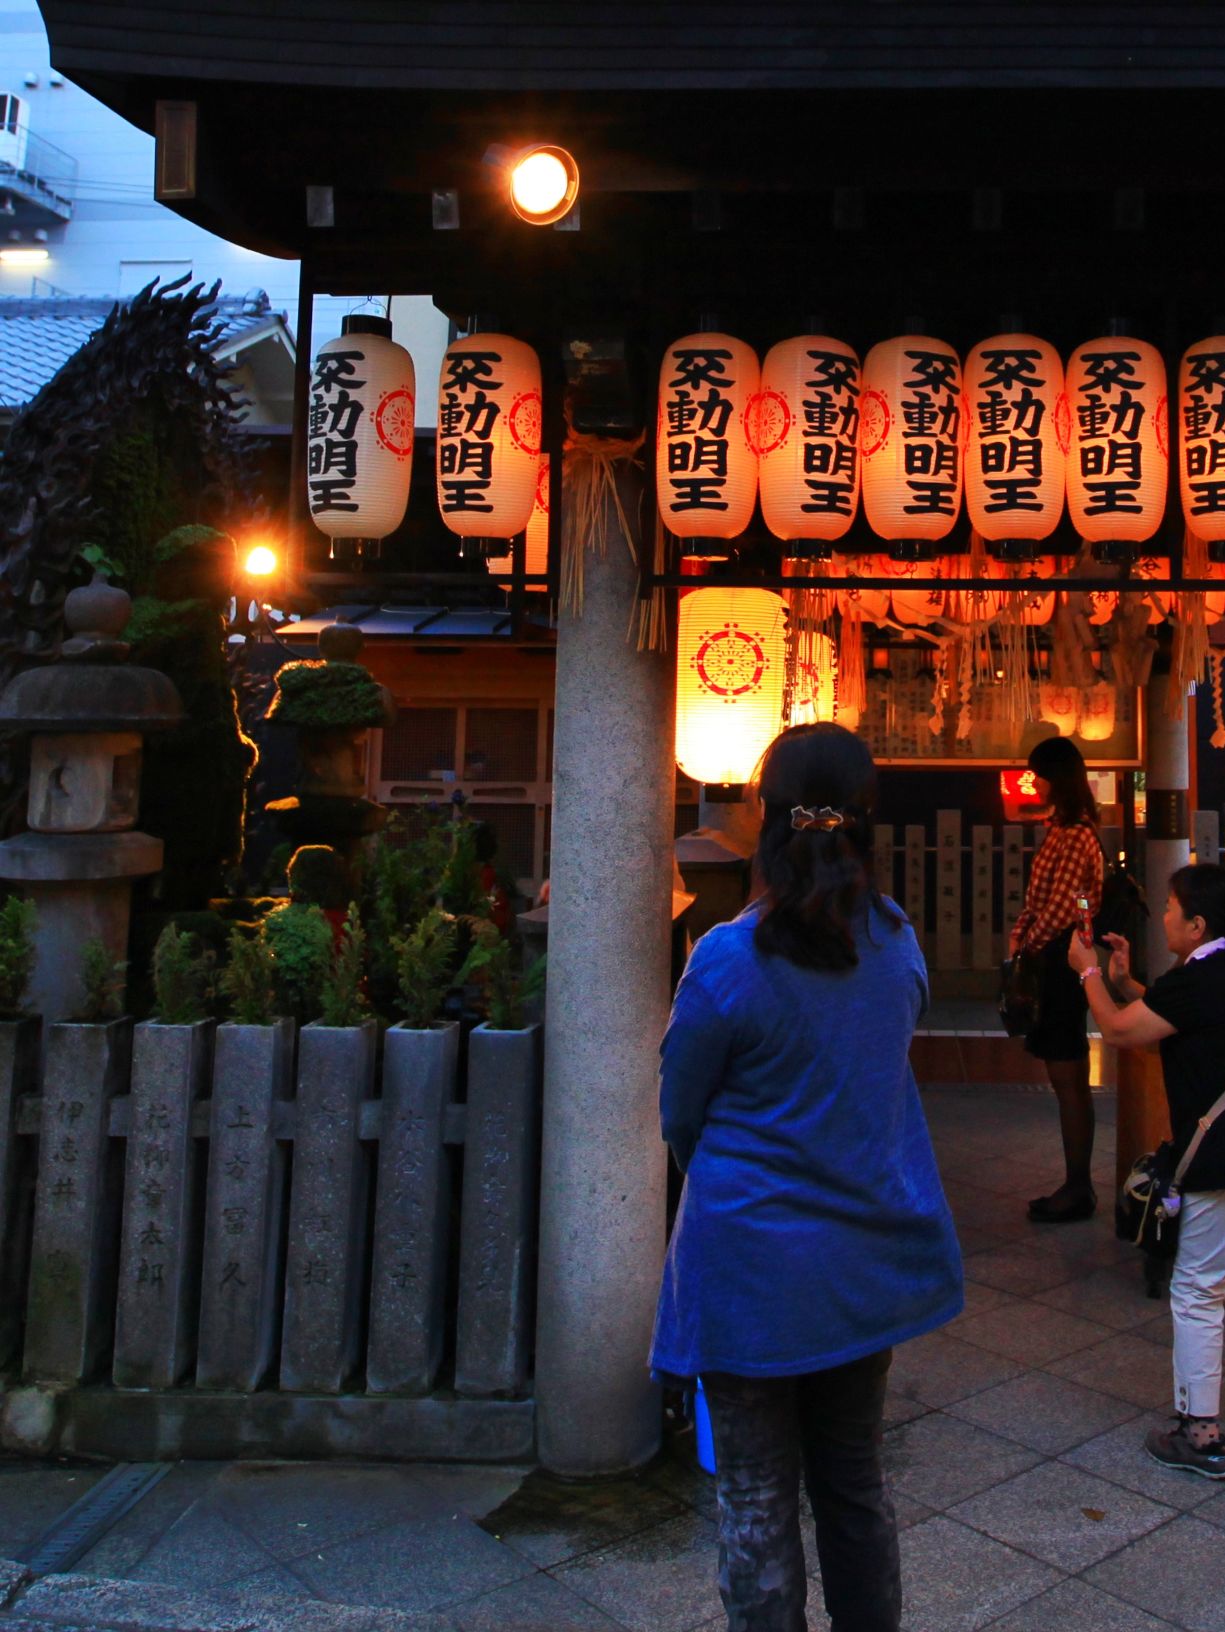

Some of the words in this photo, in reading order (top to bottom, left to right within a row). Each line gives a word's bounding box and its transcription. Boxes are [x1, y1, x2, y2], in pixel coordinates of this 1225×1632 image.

[309, 350, 367, 513] 不動明王
[439, 350, 503, 513] 不動明王
[666, 348, 734, 512] 不動明王
[801, 350, 861, 516] 不動明王
[901, 350, 960, 516] 不動明王
[978, 349, 1046, 514] 不動明王
[1078, 351, 1146, 516] 不動明王
